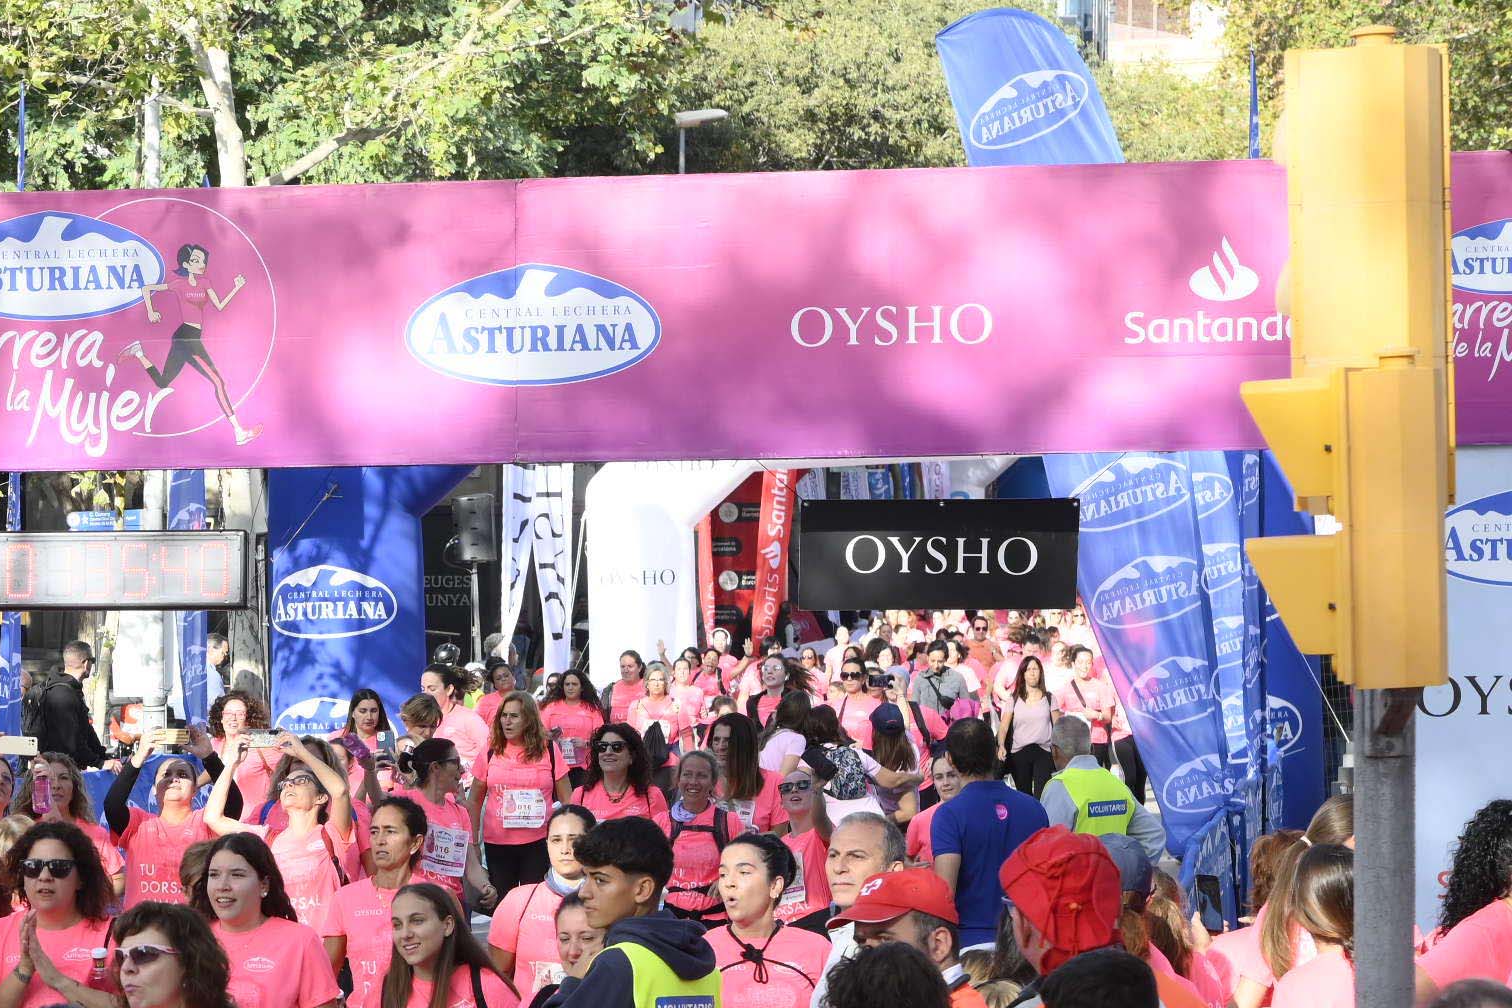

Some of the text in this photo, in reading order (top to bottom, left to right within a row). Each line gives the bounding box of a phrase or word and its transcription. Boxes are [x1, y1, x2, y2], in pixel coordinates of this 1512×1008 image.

[68, 248, 139, 259] LECHERA
[465, 304, 632, 320] CENTRAL LECHERA
[429, 311, 641, 354] ASTURIANA
[791, 302, 993, 348] OYSHO
[1124, 311, 1292, 345] Santand
[6, 370, 30, 412] la
[26, 365, 174, 458] Mujer
[845, 535, 1038, 575] OYSHO
[288, 589, 383, 600] CENTRAL LECHERA
[275, 594, 388, 622] ASTURIANA
[289, 722, 331, 731] CENTRAL
[1089, 802, 1127, 815] VOLUNTARIS
[140, 864, 155, 875] TU
[140, 881, 181, 894] DORS
